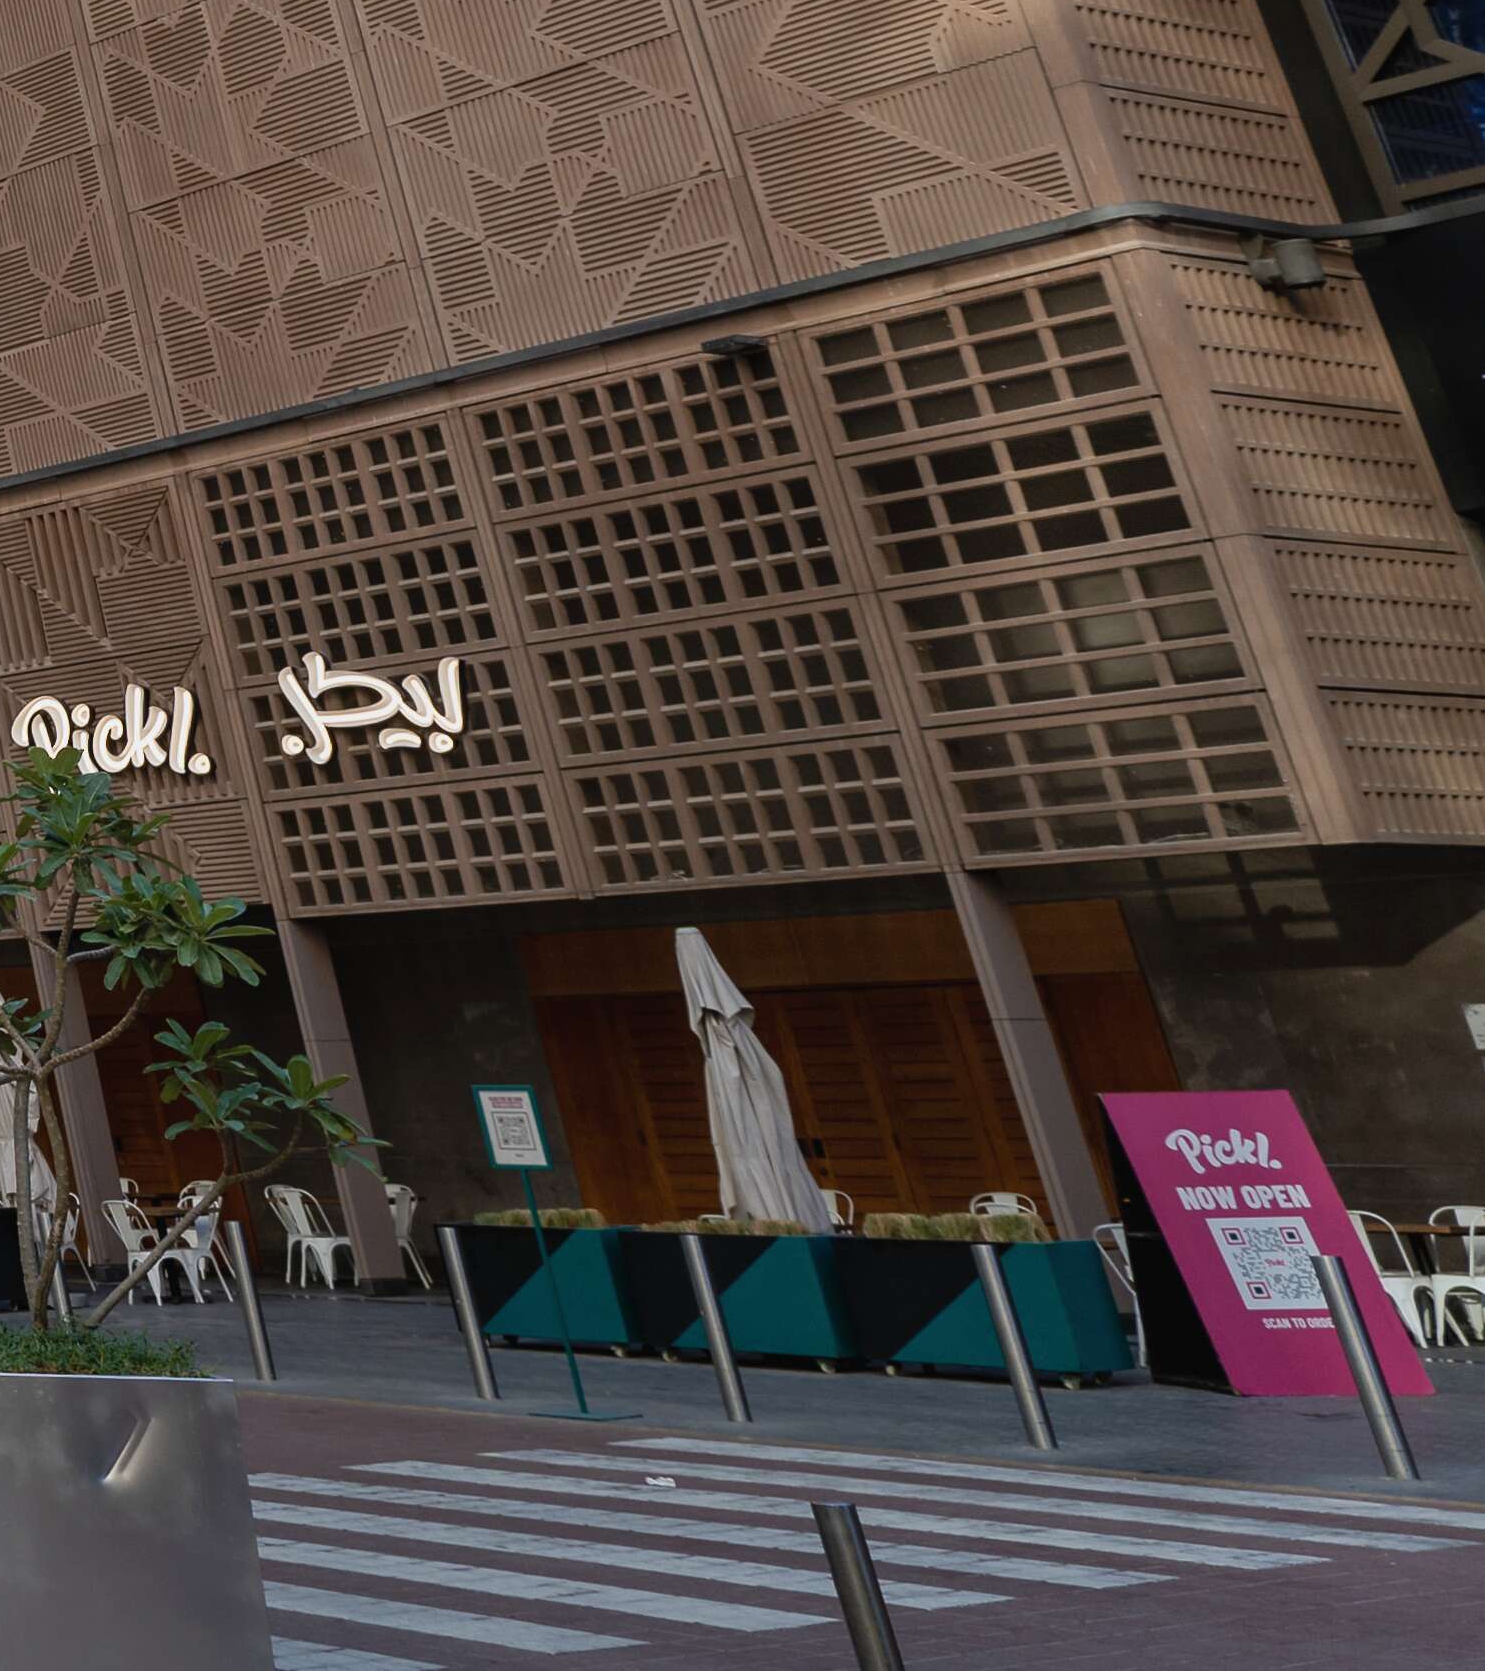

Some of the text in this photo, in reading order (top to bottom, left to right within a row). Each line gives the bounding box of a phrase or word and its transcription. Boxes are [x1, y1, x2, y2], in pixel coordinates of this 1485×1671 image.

[1165, 1128, 1283, 1174] Pickl.
[1176, 1184, 1312, 1210] NOW OPEN
[1262, 1316, 1336, 1329] SCAN TO ORDE
